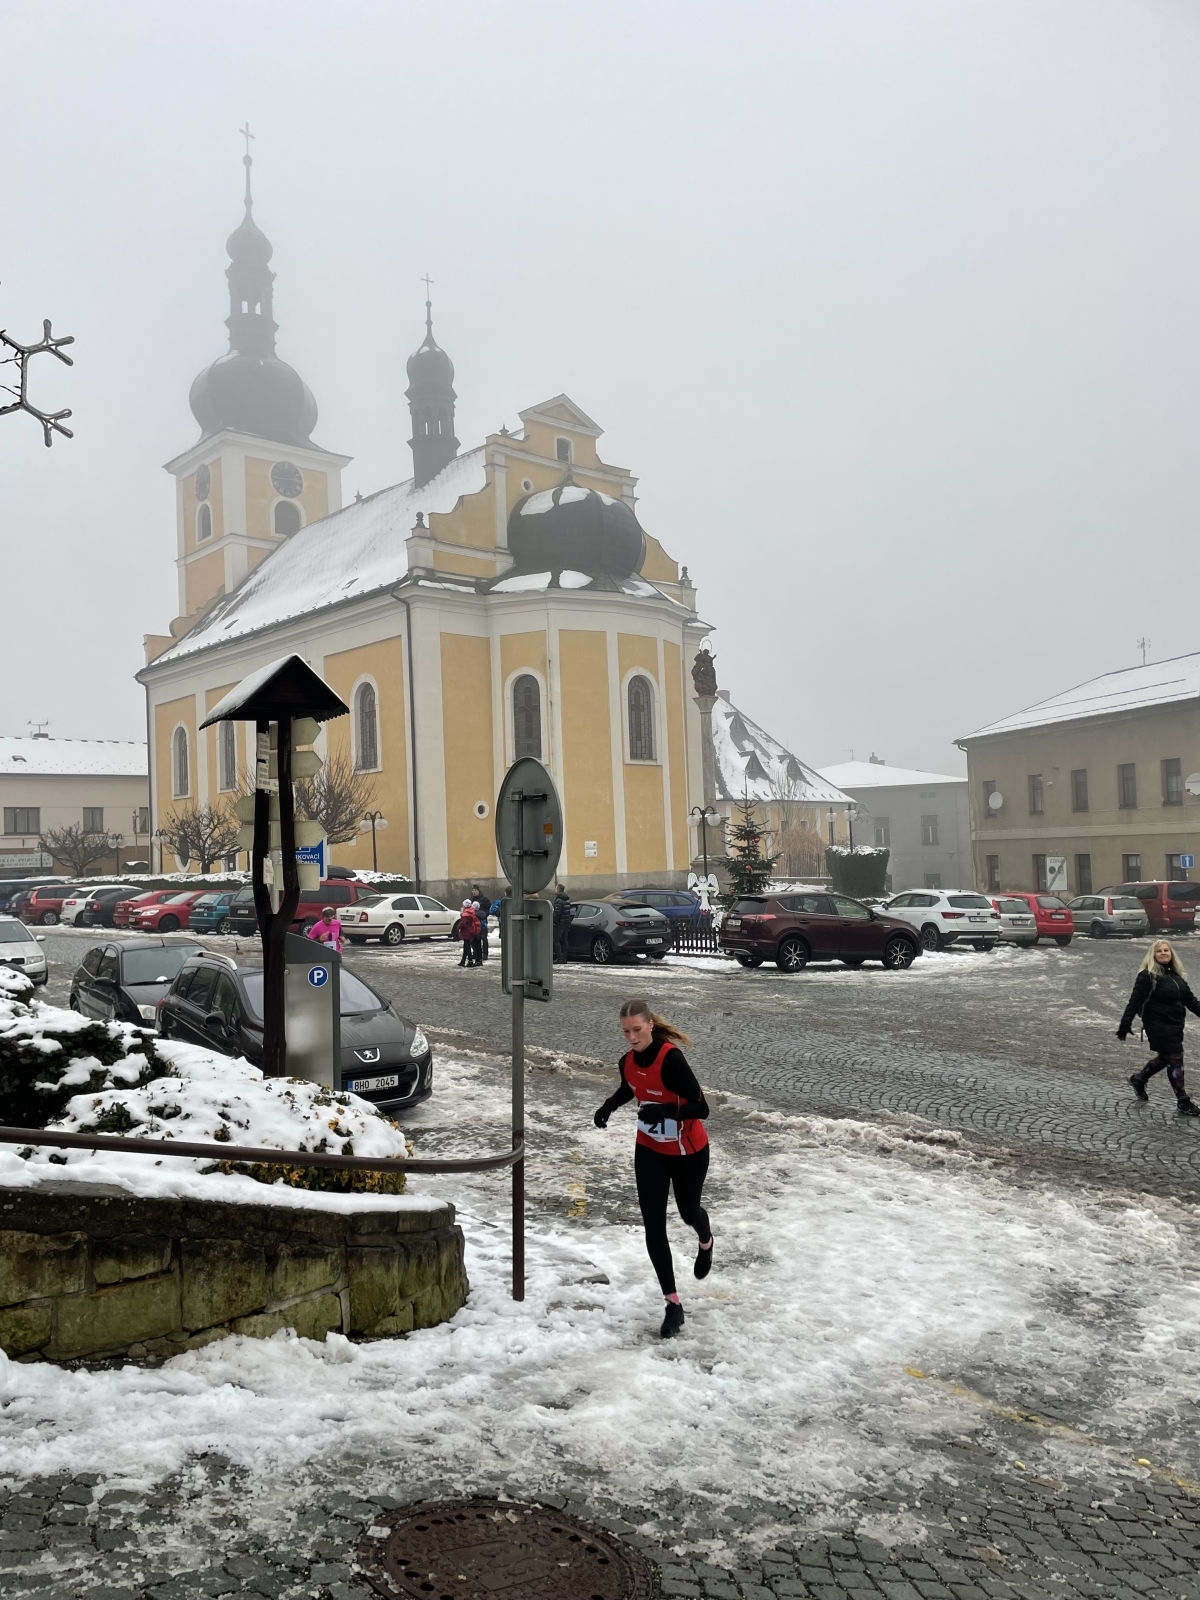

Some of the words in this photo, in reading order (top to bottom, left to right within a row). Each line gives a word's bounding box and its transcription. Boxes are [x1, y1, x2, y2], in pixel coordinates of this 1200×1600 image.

[313, 970, 324, 983] P
[354, 1080, 370, 1090] 8H0
[375, 1077, 395, 1088] 2045
[648, 1118, 665, 1135] 21
